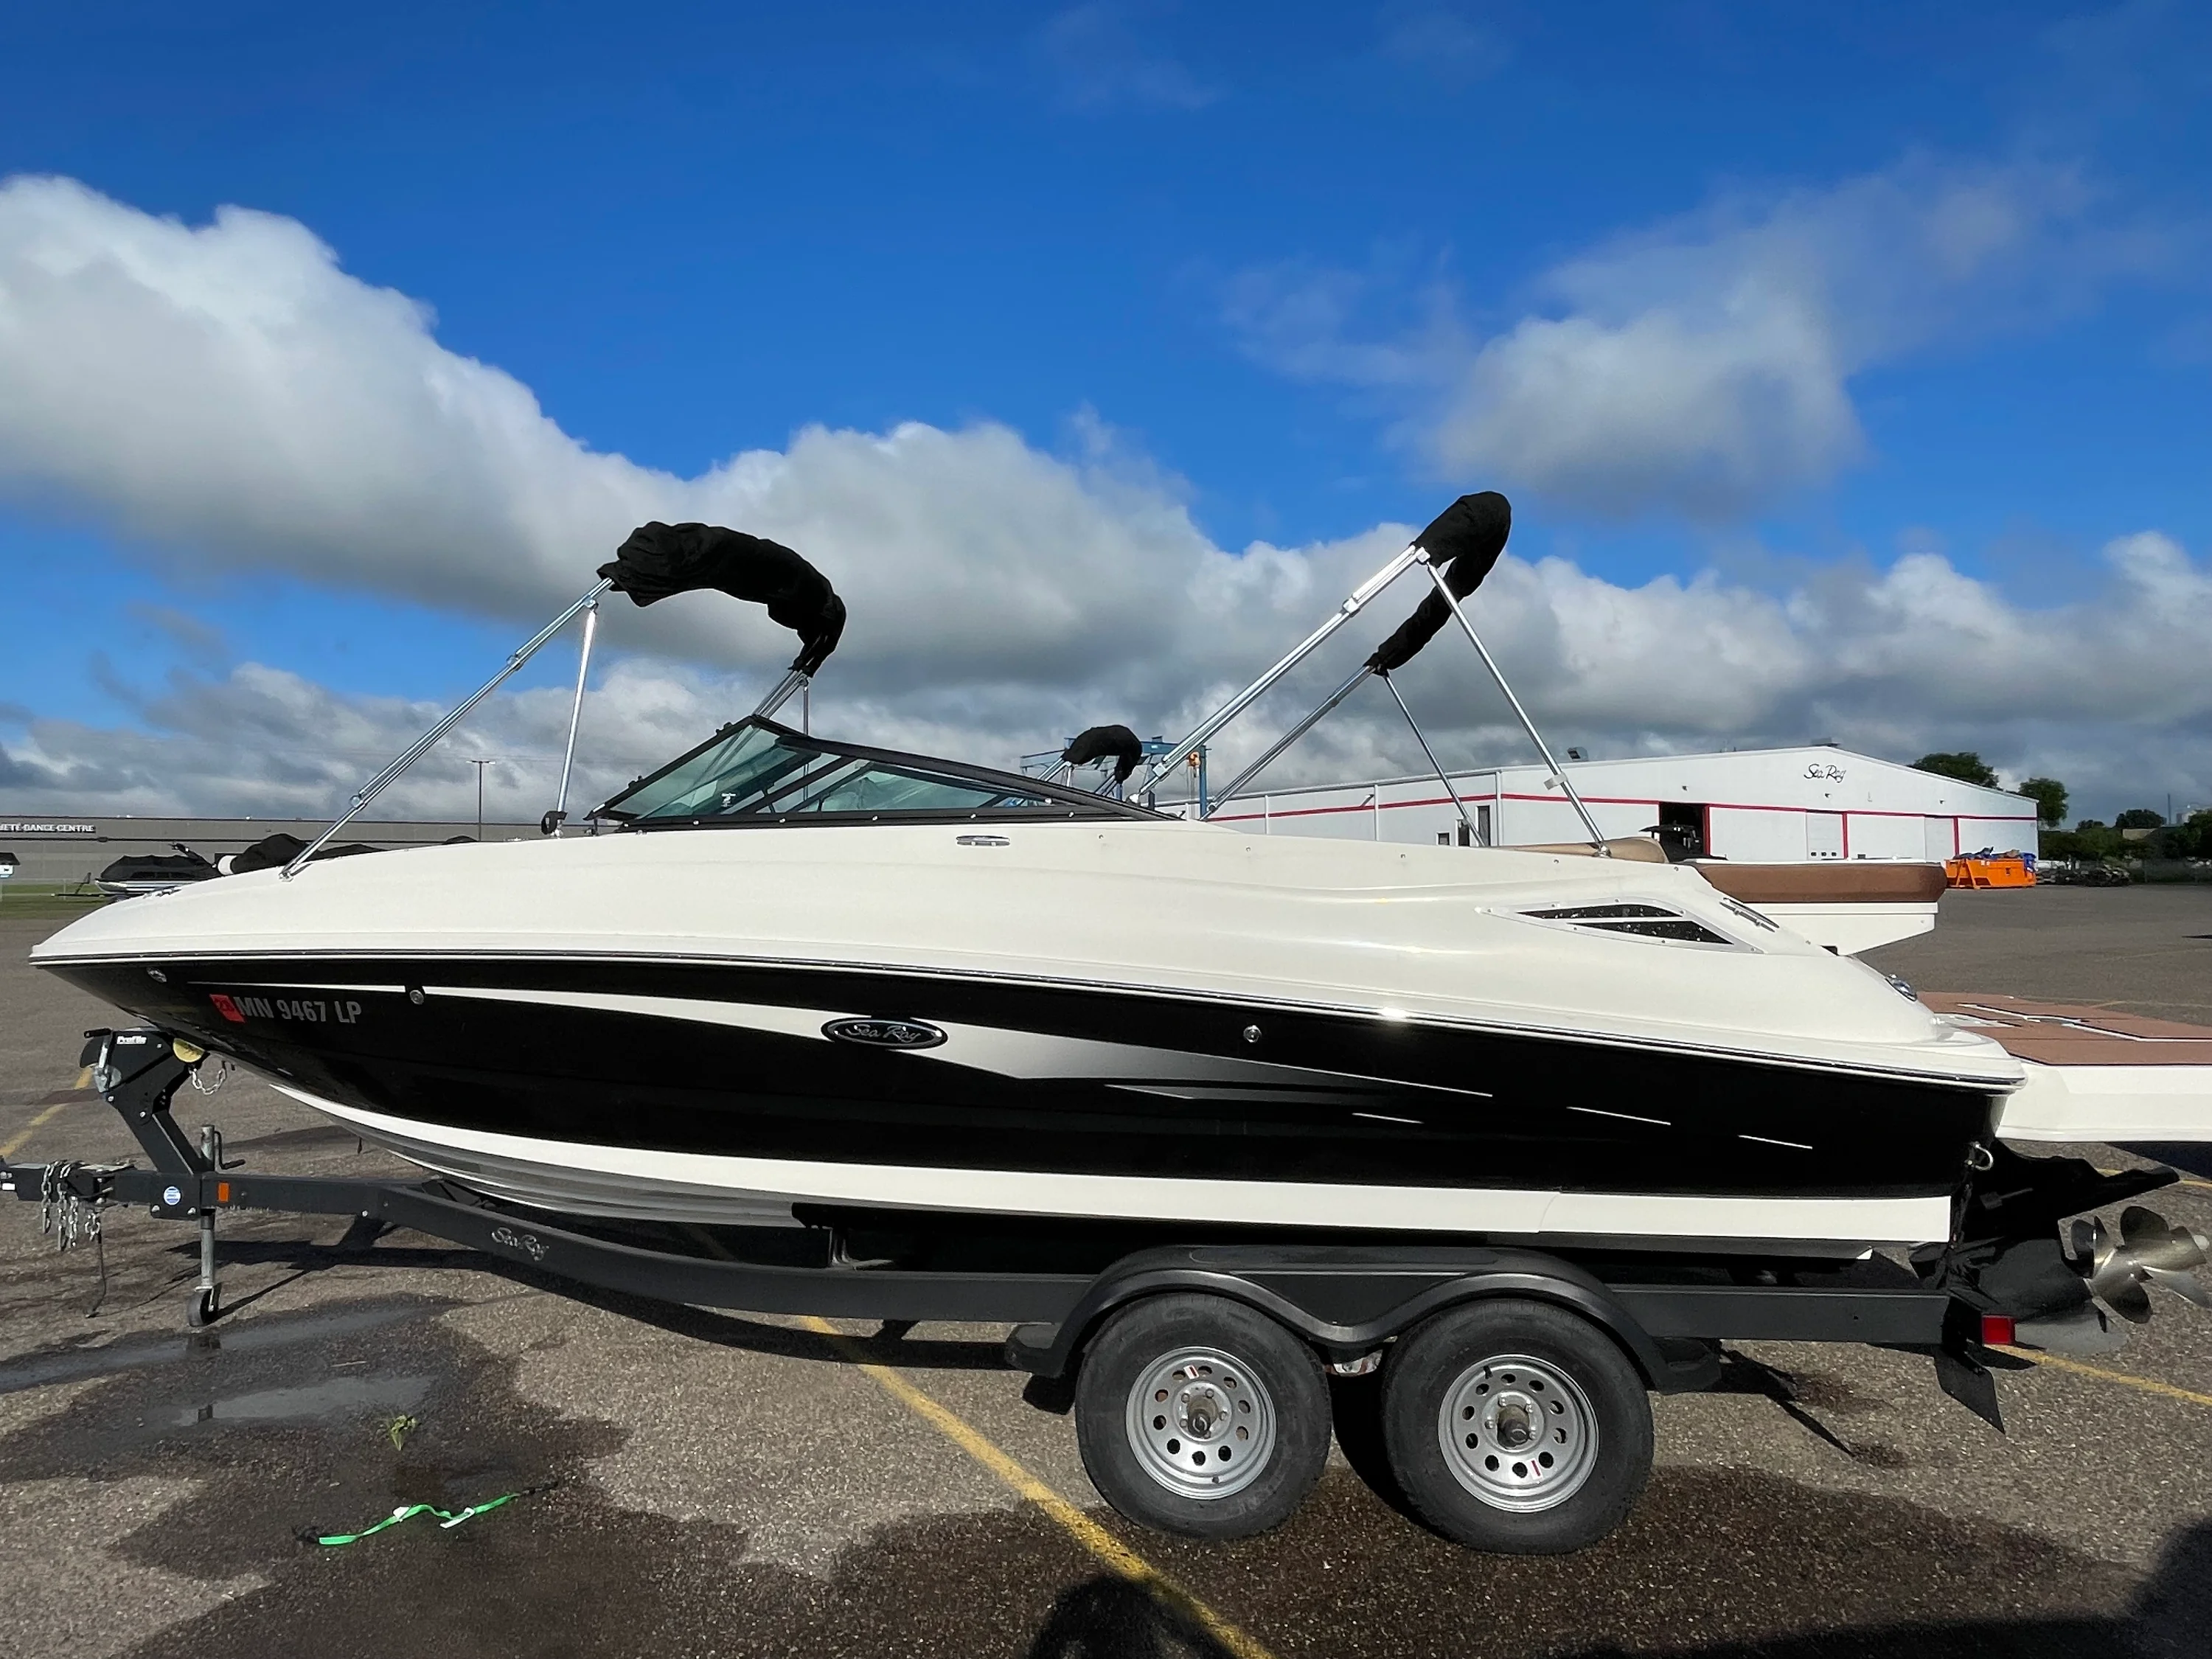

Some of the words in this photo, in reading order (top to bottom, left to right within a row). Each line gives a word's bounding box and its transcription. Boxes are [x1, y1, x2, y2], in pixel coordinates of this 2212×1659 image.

[1804, 763, 1825, 779] Sea
[1826, 765, 1846, 783] Ray
[56, 824, 95, 832] CENTRE
[233, 997, 274, 1018] MN
[276, 1000, 327, 1022] 9467
[334, 1001, 362, 1023] LP
[846, 1023, 880, 1037] Sea
[883, 1025, 921, 1043] Ray
[491, 1227, 518, 1248] Sea
[519, 1234, 550, 1262] Ray
